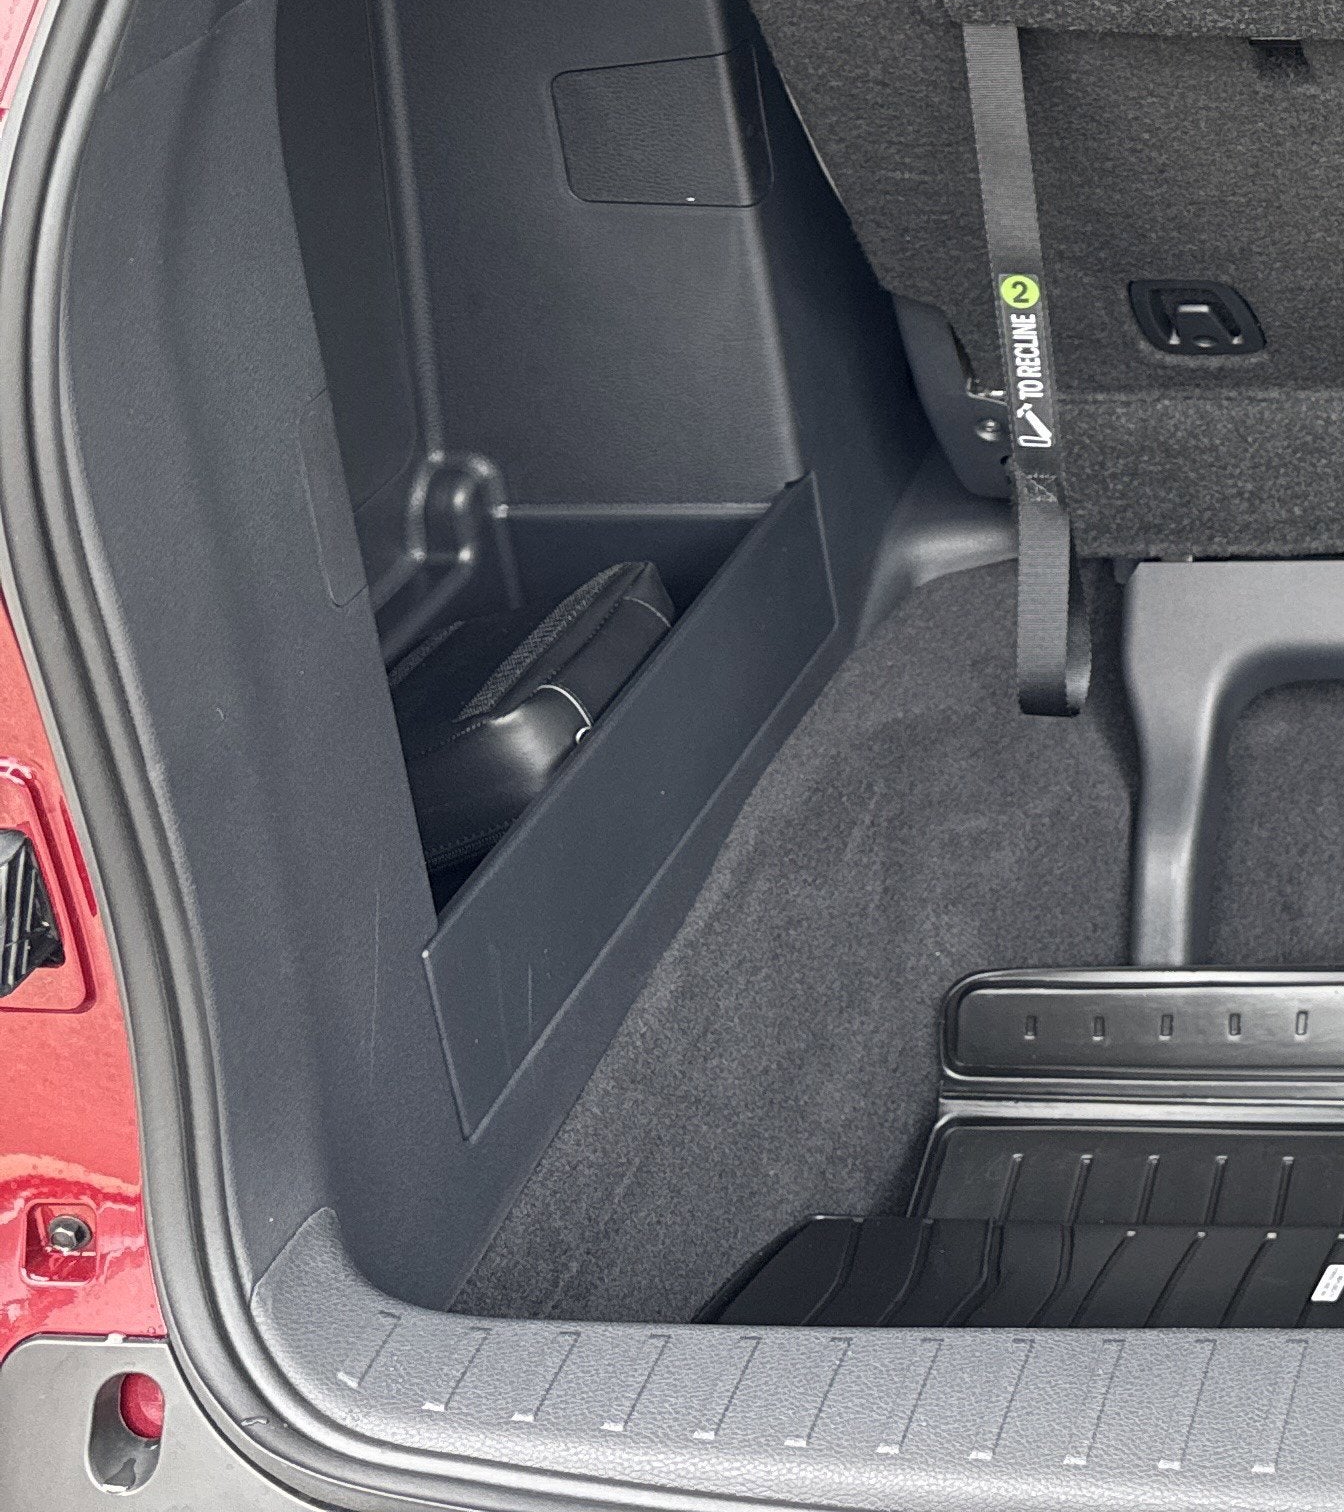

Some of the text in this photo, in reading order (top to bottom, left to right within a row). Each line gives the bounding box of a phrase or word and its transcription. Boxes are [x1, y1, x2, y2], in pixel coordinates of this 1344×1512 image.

[1011, 280, 1030, 304] 2
[1011, 313, 1044, 400] TO RECLINE
